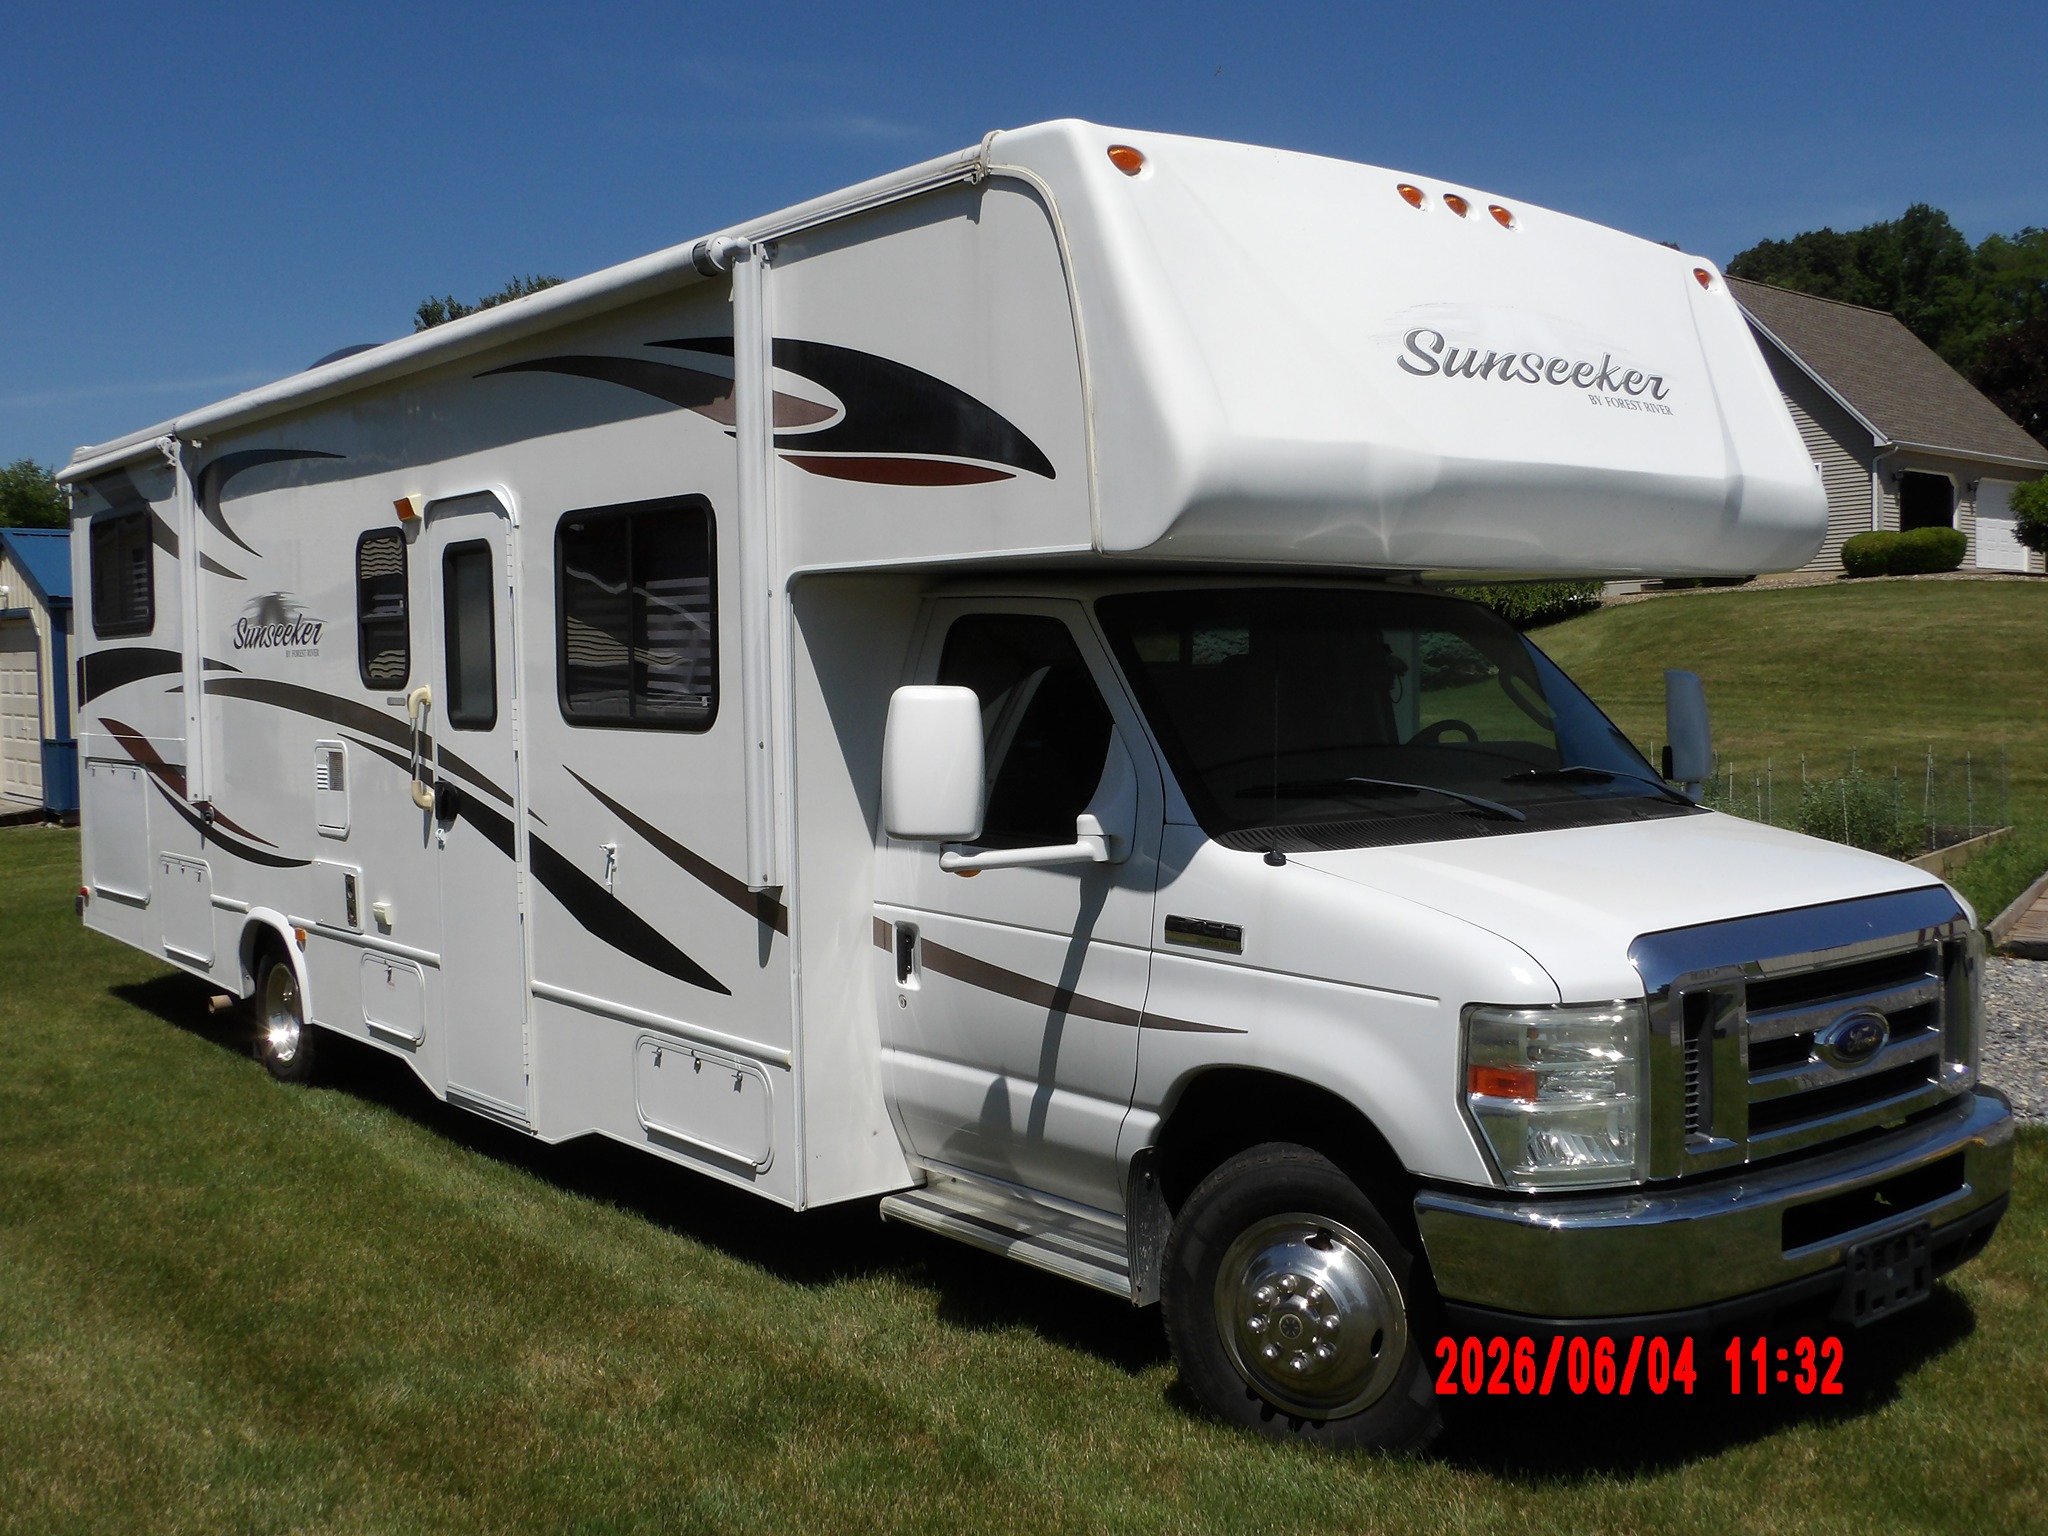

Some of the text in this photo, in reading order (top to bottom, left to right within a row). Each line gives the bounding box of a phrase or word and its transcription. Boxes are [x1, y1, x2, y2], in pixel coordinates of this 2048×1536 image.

[1397, 328, 1670, 401] Sunseeker
[1588, 394, 1674, 416] BY FOREST RIVER
[233, 613, 324, 650] Sunseeker
